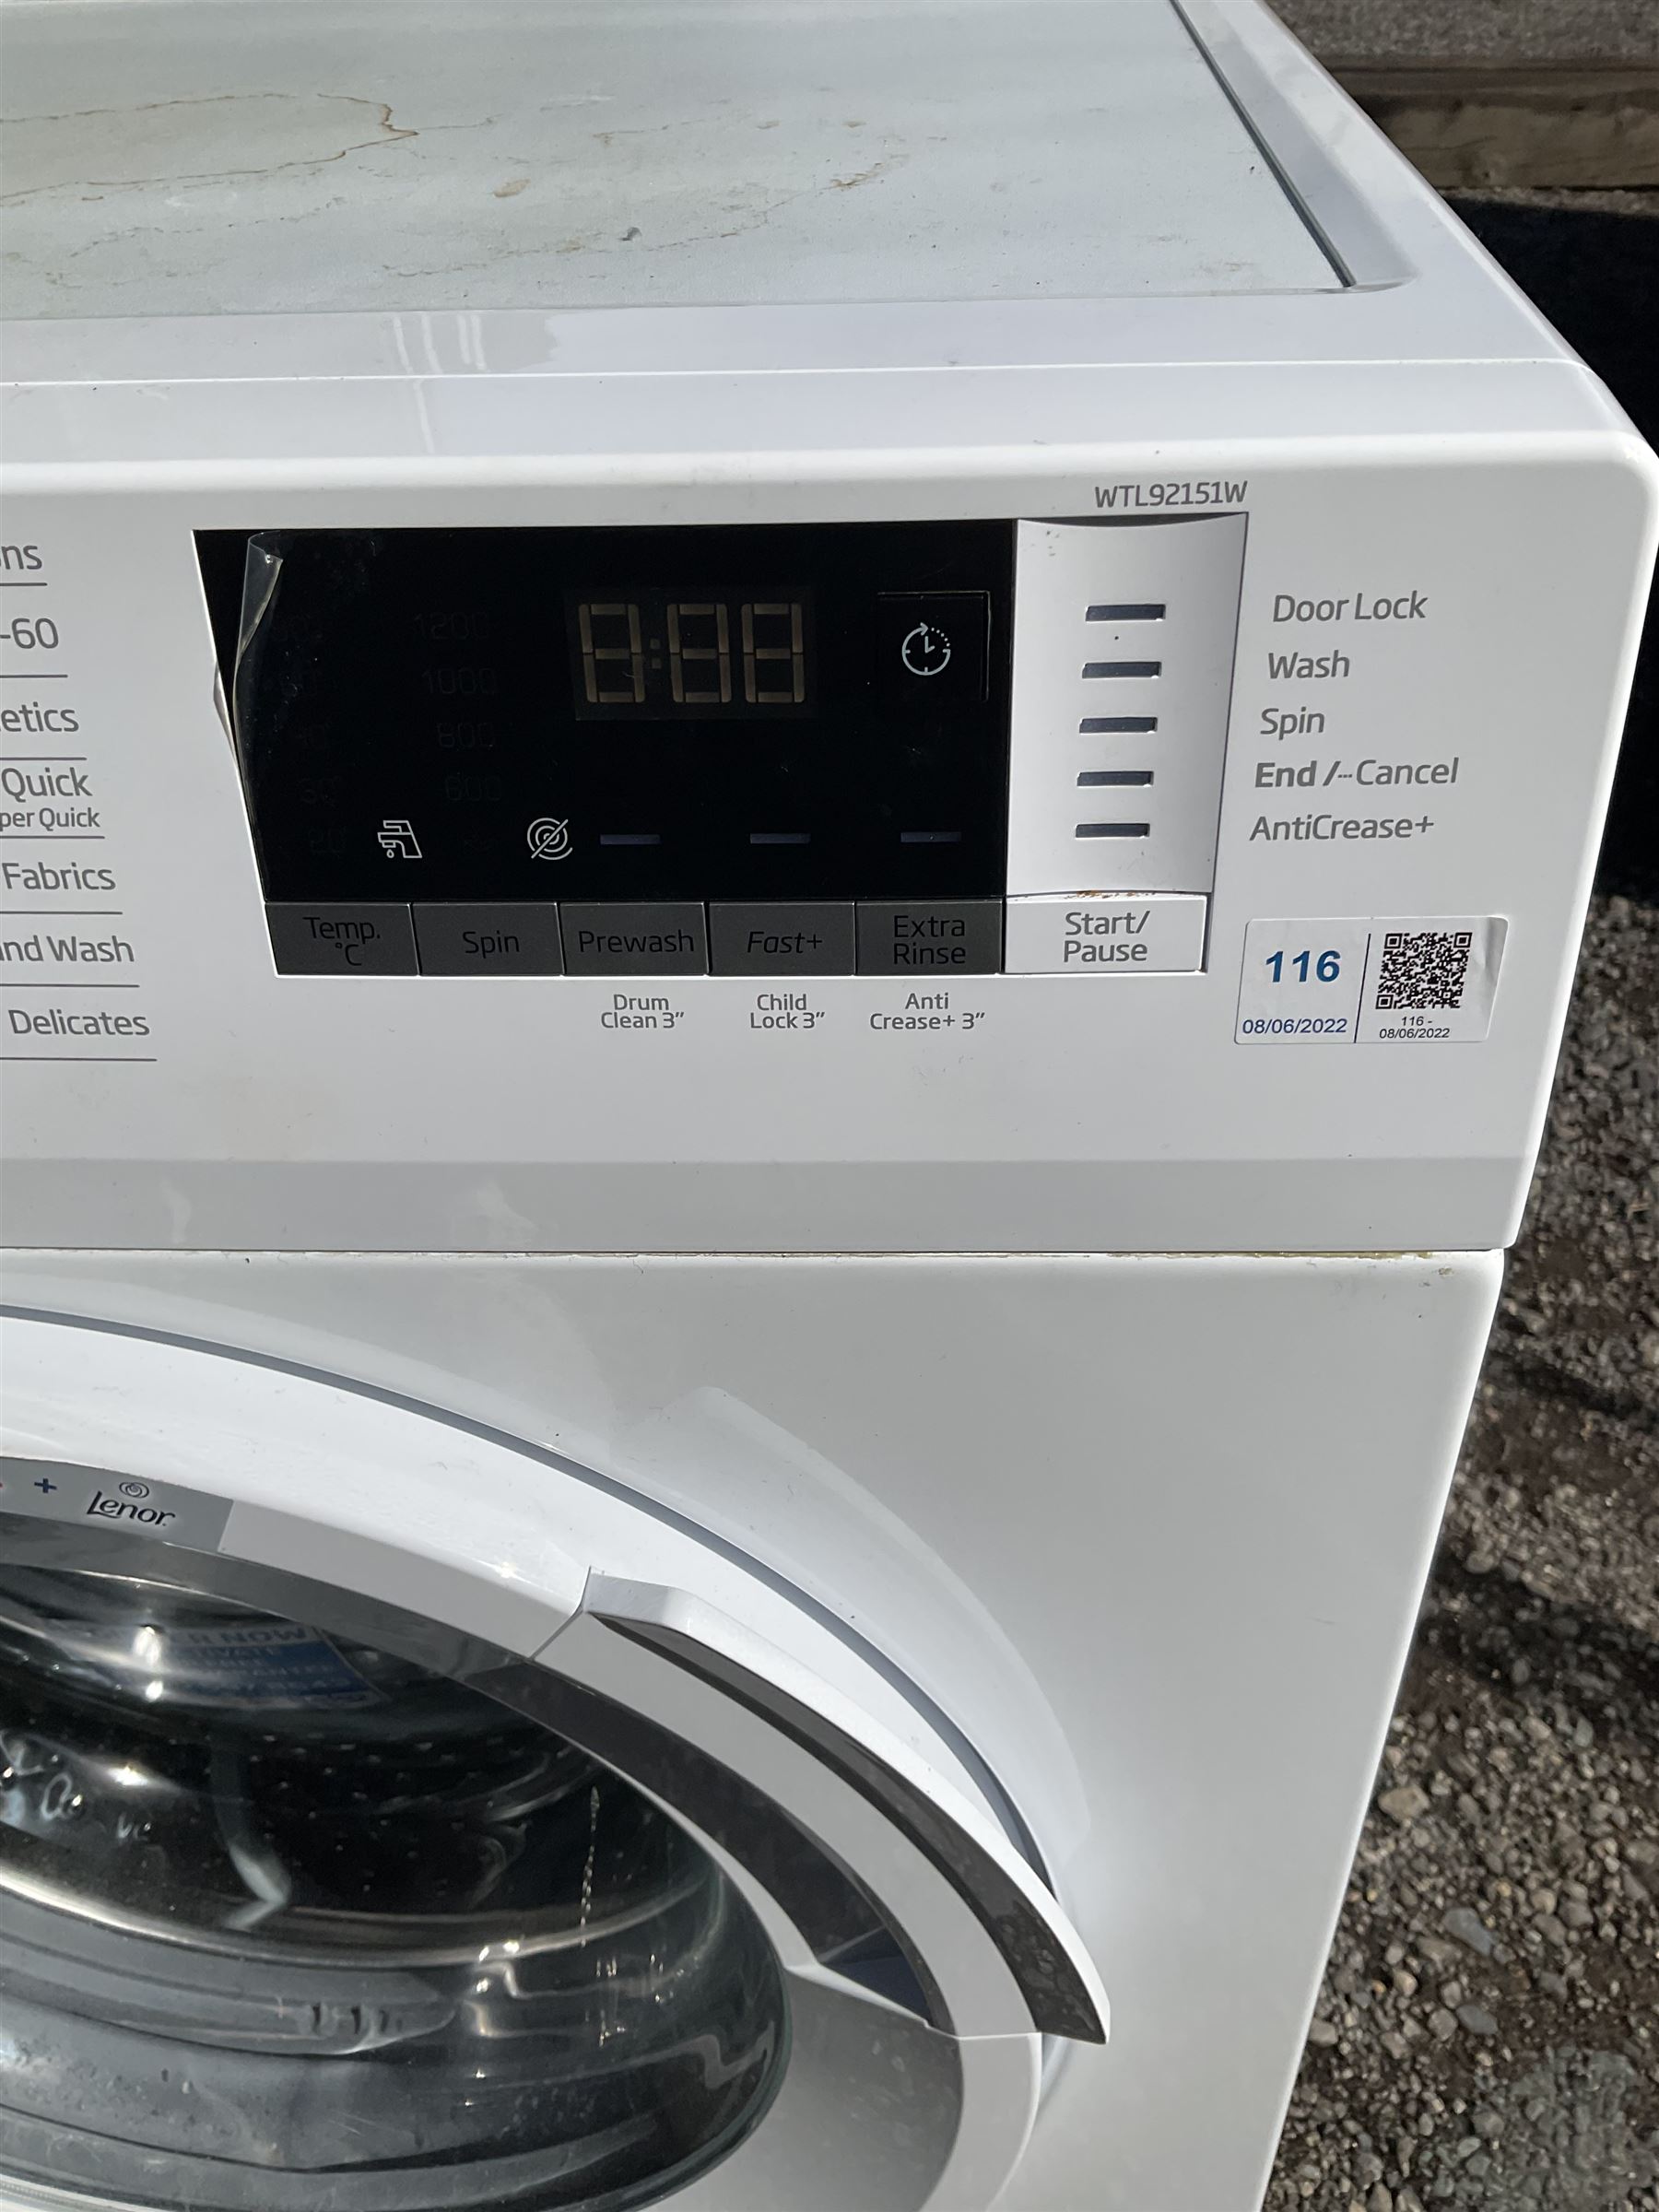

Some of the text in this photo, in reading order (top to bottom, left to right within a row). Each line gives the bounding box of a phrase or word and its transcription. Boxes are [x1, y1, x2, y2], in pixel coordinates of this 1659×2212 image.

[1094, 480, 1248, 508] WTL92151W
[0, 545, 42, 571] ns
[1273, 590, 1429, 623] Door Lock
[1268, 649, 1350, 679] Wash
[0, 700, 79, 733] etics
[1260, 706, 1325, 741] Spin
[1, 767, 93, 803] Quick
[1254, 759, 1318, 788] End
[39, 806, 100, 832] Quick
[1249, 814, 1435, 841] AntiCrease+
[1, 861, 116, 890] Fabrics
[302, 917, 381, 945] Temp.
[893, 914, 965, 938] Extra
[1065, 910, 1151, 935] Start/
[0, 935, 135, 962] nd Wash
[462, 929, 520, 959] Spin
[578, 928, 694, 953] Prewash
[747, 931, 823, 954] Fast+
[893, 941, 966, 965] Rinse
[1064, 940, 1147, 963] Pause
[335, 943, 363, 967] °C
[1265, 950, 1341, 982] 116
[613, 994, 670, 1011] Drum
[756, 994, 807, 1011] Child
[904, 992, 949, 1010] Anti
[7, 1008, 150, 1036] Delicates
[601, 1011, 657, 1029] Clean
[750, 1011, 798, 1029] Lock
[870, 1013, 956, 1030] Crease+
[1242, 1018, 1347, 1034] 08/06/2022
[1402, 1016, 1424, 1027] 116
[1379, 1028, 1451, 1039] 08/06/2022
[87, 1489, 176, 1527] Lenor
